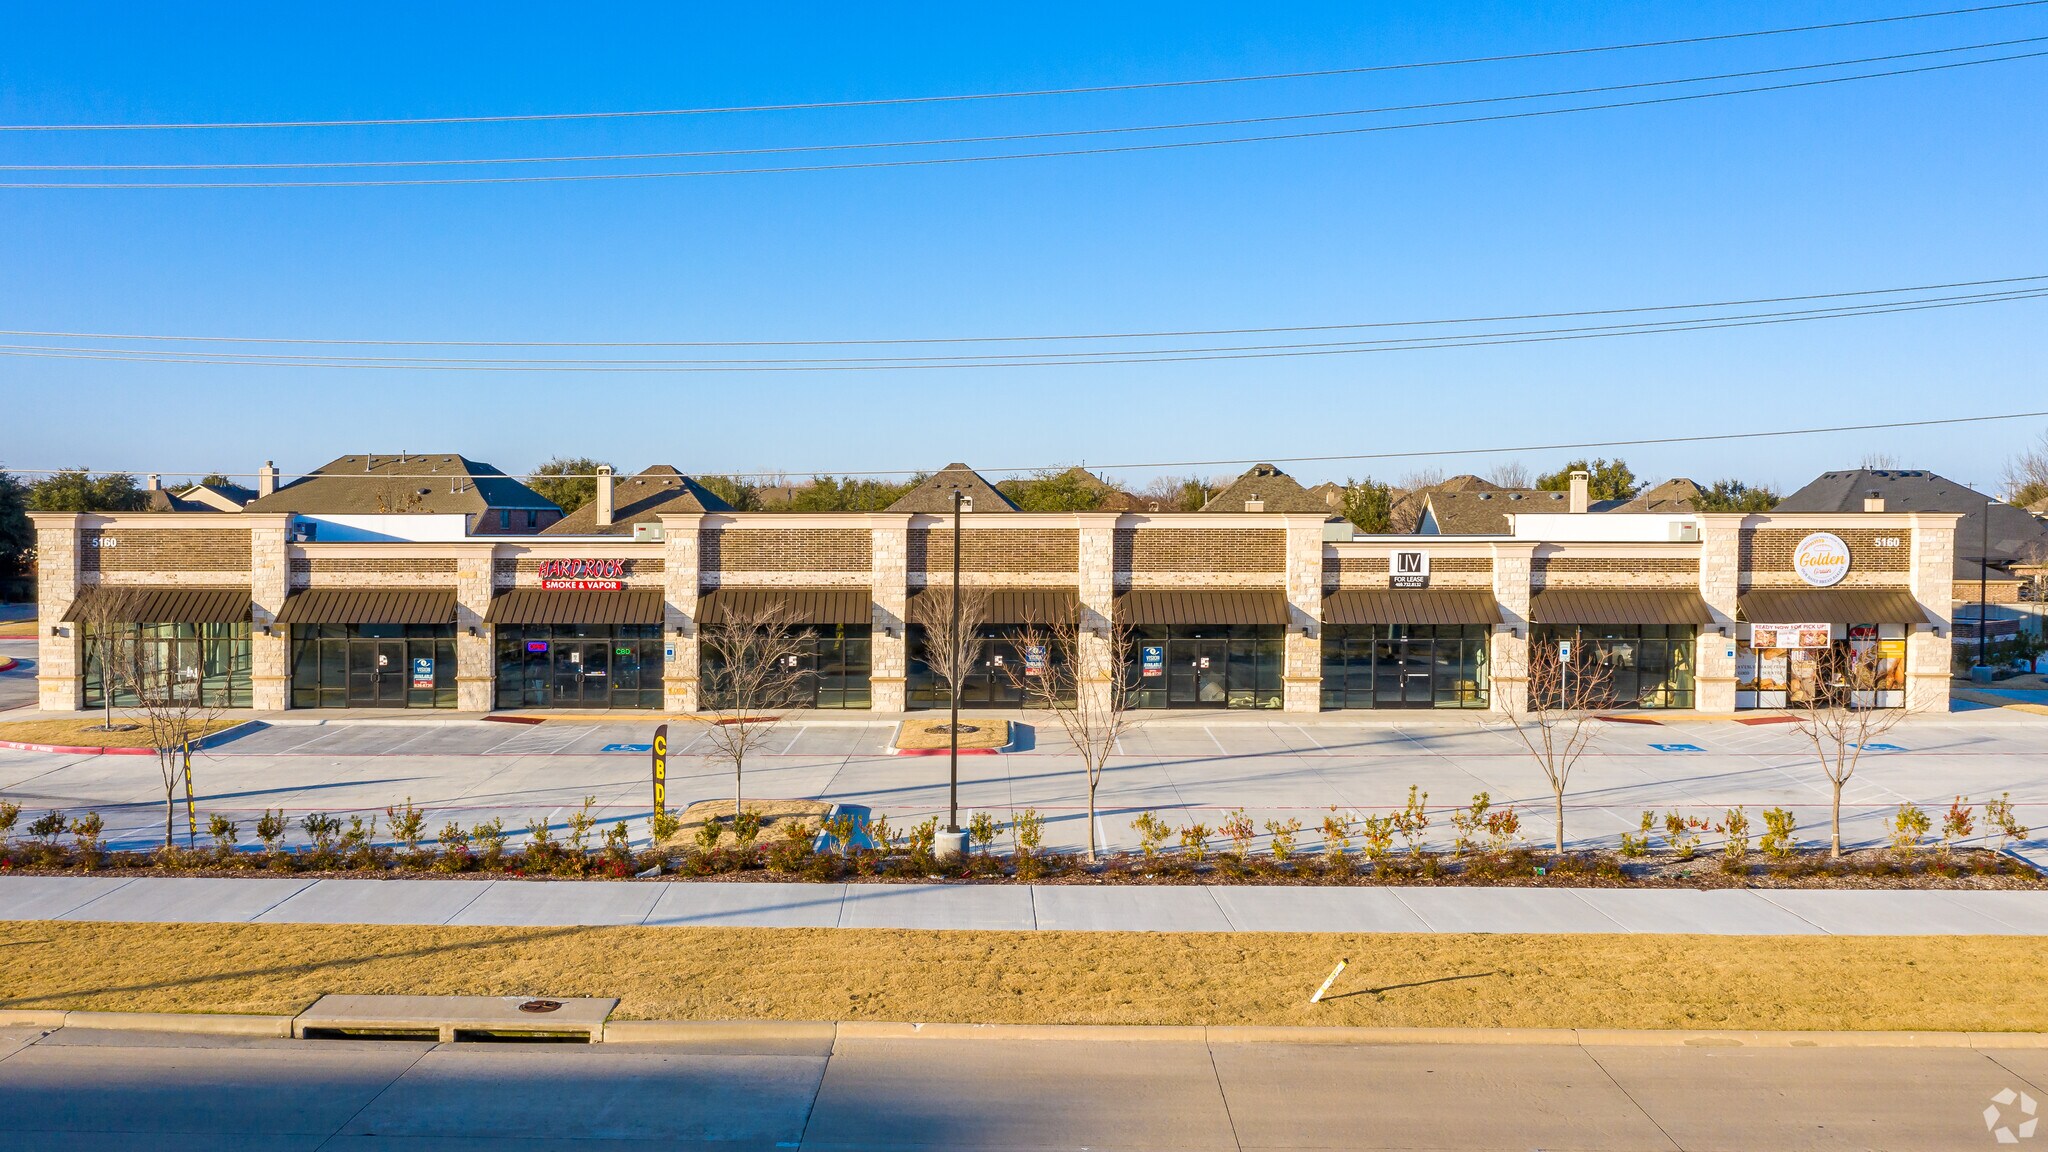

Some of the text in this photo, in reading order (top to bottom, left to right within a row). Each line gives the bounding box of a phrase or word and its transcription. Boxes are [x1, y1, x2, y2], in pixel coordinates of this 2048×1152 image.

[92, 537, 117, 547] 5160
[1874, 537, 1900, 547] 5160
[1398, 554, 1421, 572] LIV
[1799, 552, 1846, 567] Golden
[538, 557, 625, 578] HARD ROCK
[546, 581, 617, 589] SMOKE & VAPOR
[654, 735, 667, 803] CBD
